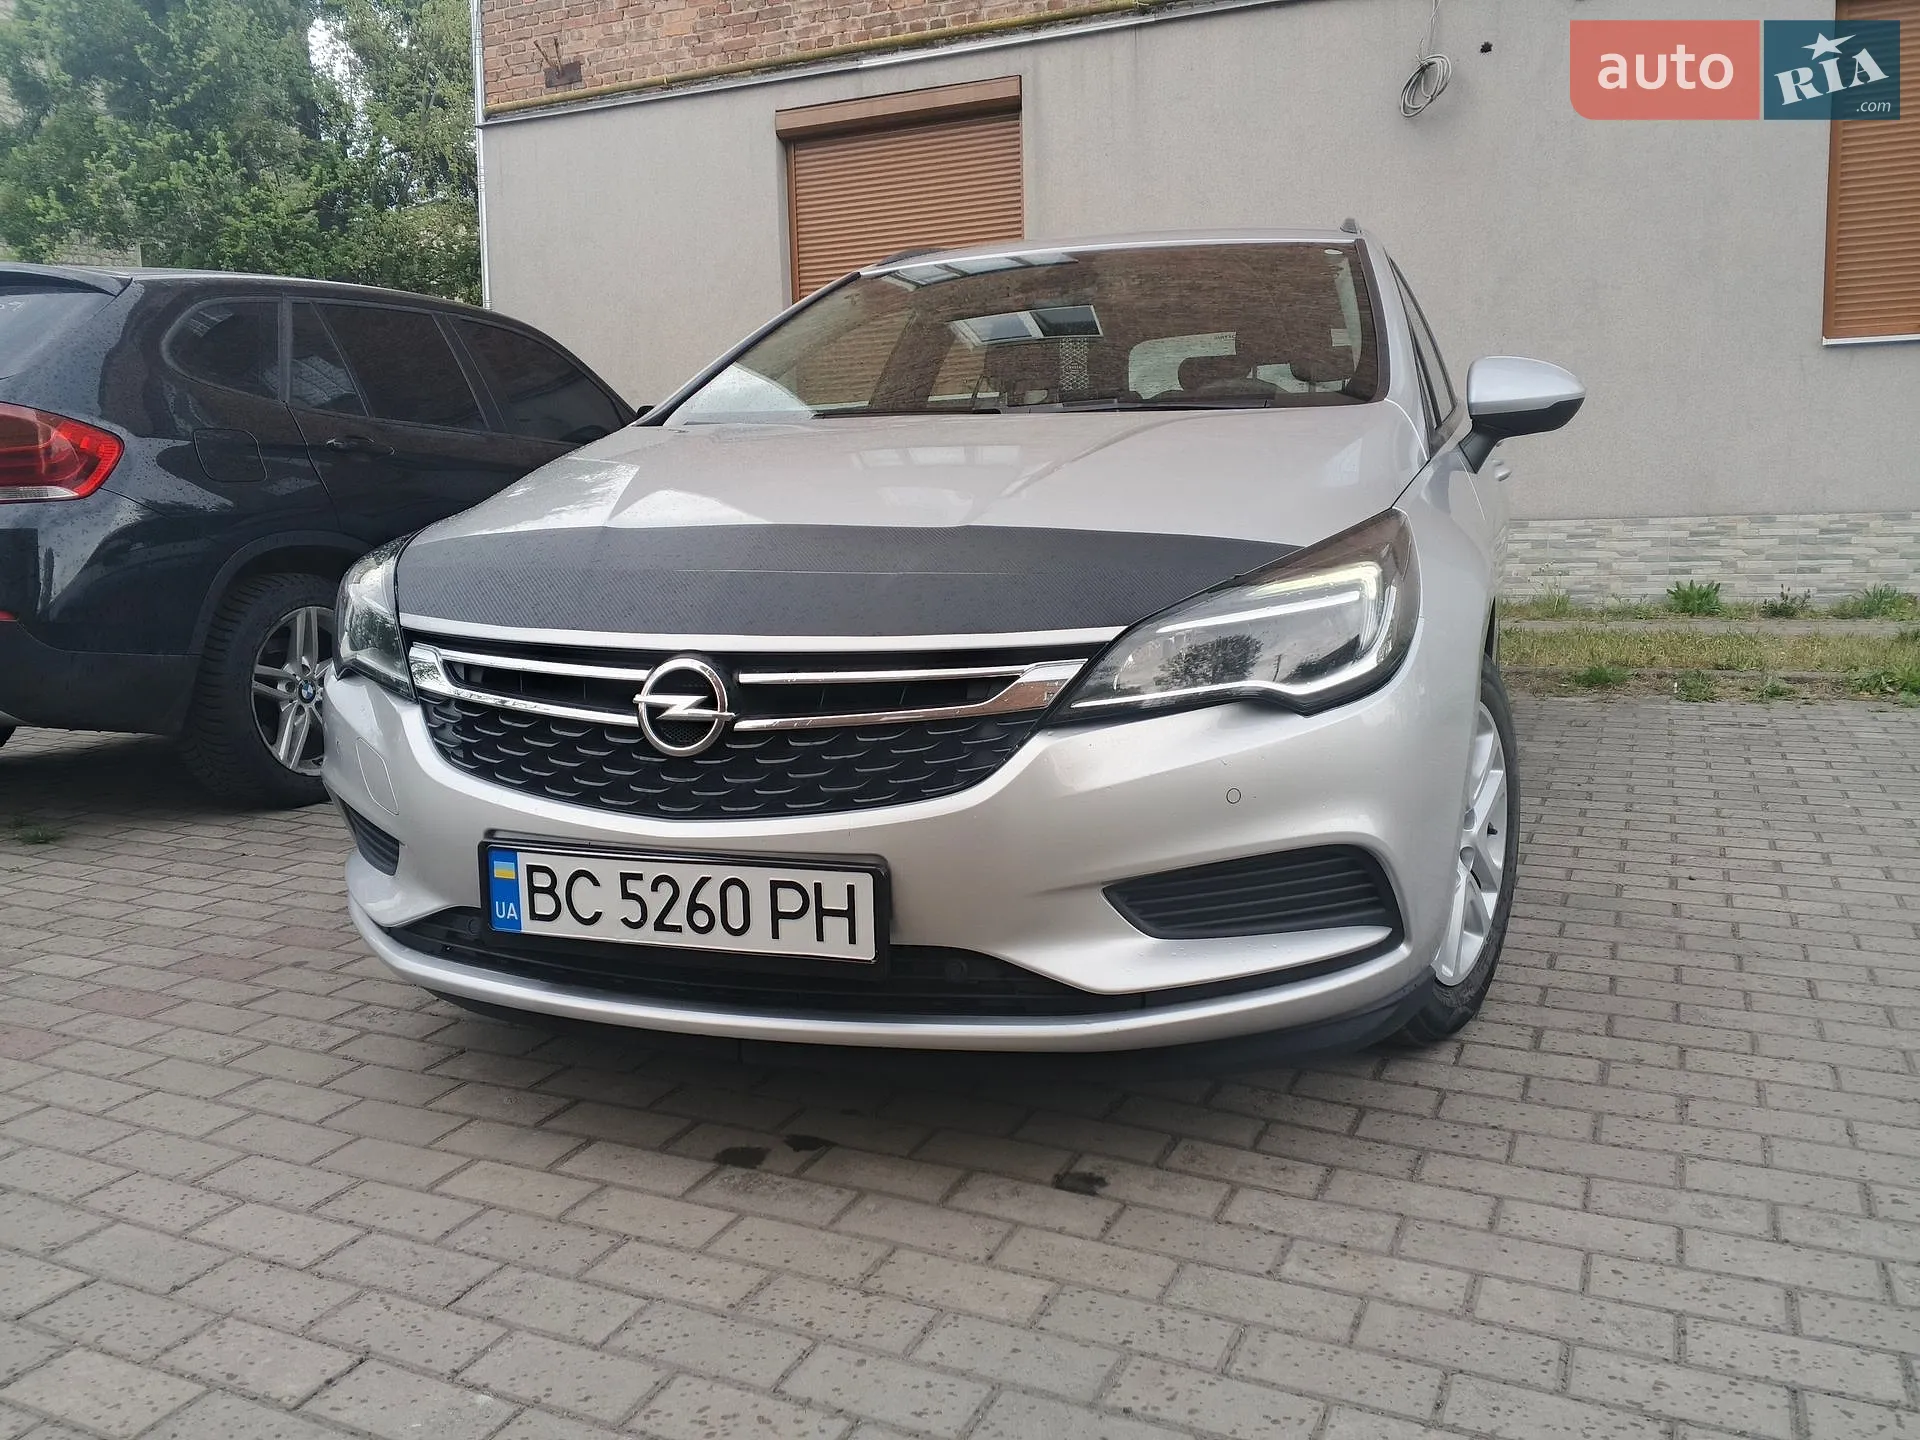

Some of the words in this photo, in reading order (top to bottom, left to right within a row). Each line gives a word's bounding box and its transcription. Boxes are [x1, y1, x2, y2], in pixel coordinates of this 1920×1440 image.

[495, 901, 519, 920] UA
[526, 864, 603, 926] BC
[619, 872, 751, 937] 5260
[769, 880, 857, 945] PH
